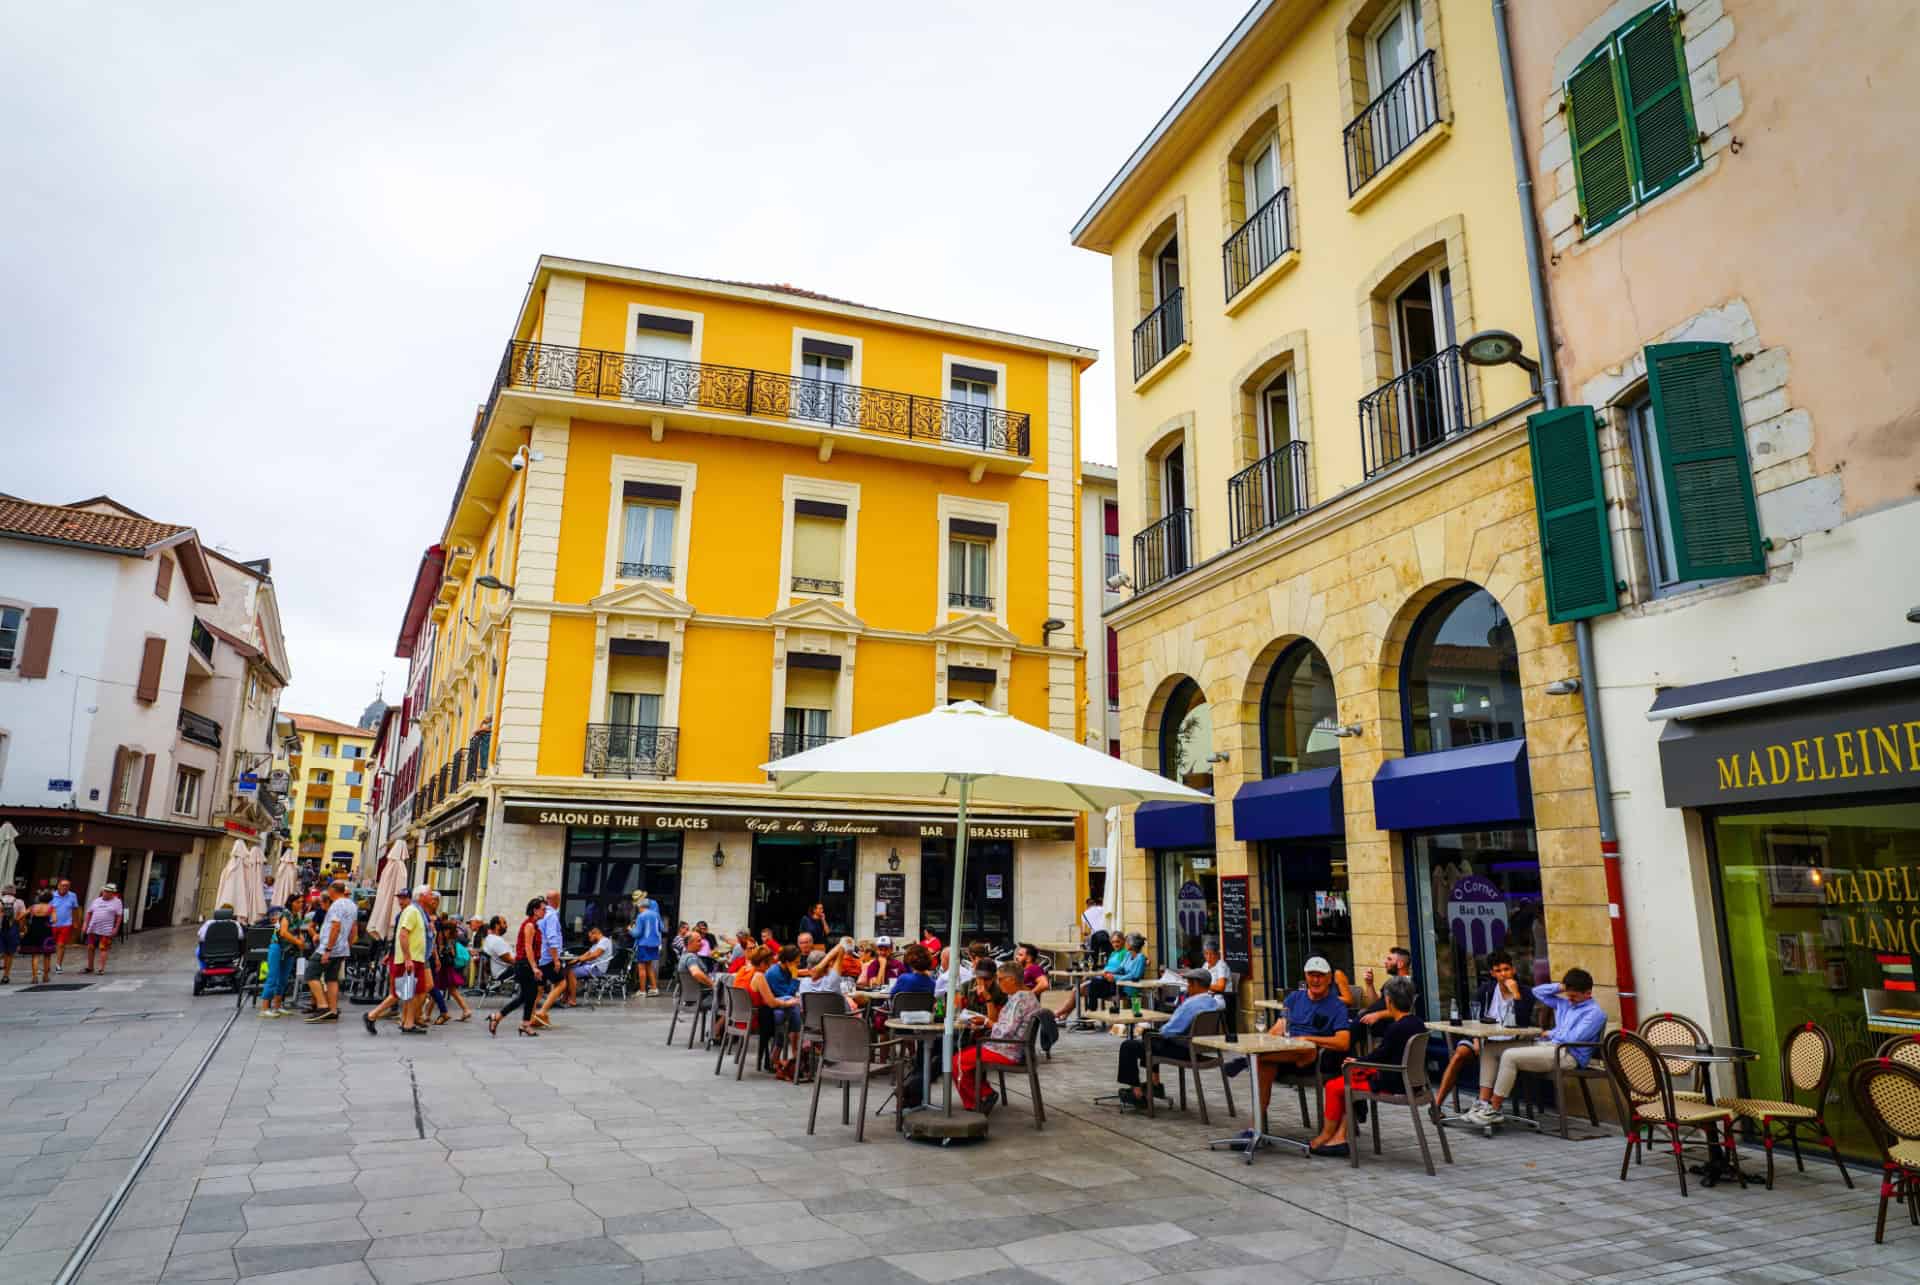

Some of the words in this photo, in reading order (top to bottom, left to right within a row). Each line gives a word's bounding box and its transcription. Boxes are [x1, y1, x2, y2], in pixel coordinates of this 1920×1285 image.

[539, 811, 589, 826] SALON
[592, 813, 611, 826] DE
[614, 815, 641, 827] THE
[655, 816, 709, 830] GLACES
[786, 819, 806, 833] de
[810, 819, 880, 834] Bordeaux
[919, 825, 944, 837] BAR
[969, 826, 1030, 840] BRASSERIE
[1823, 865, 1920, 905] MADEL
